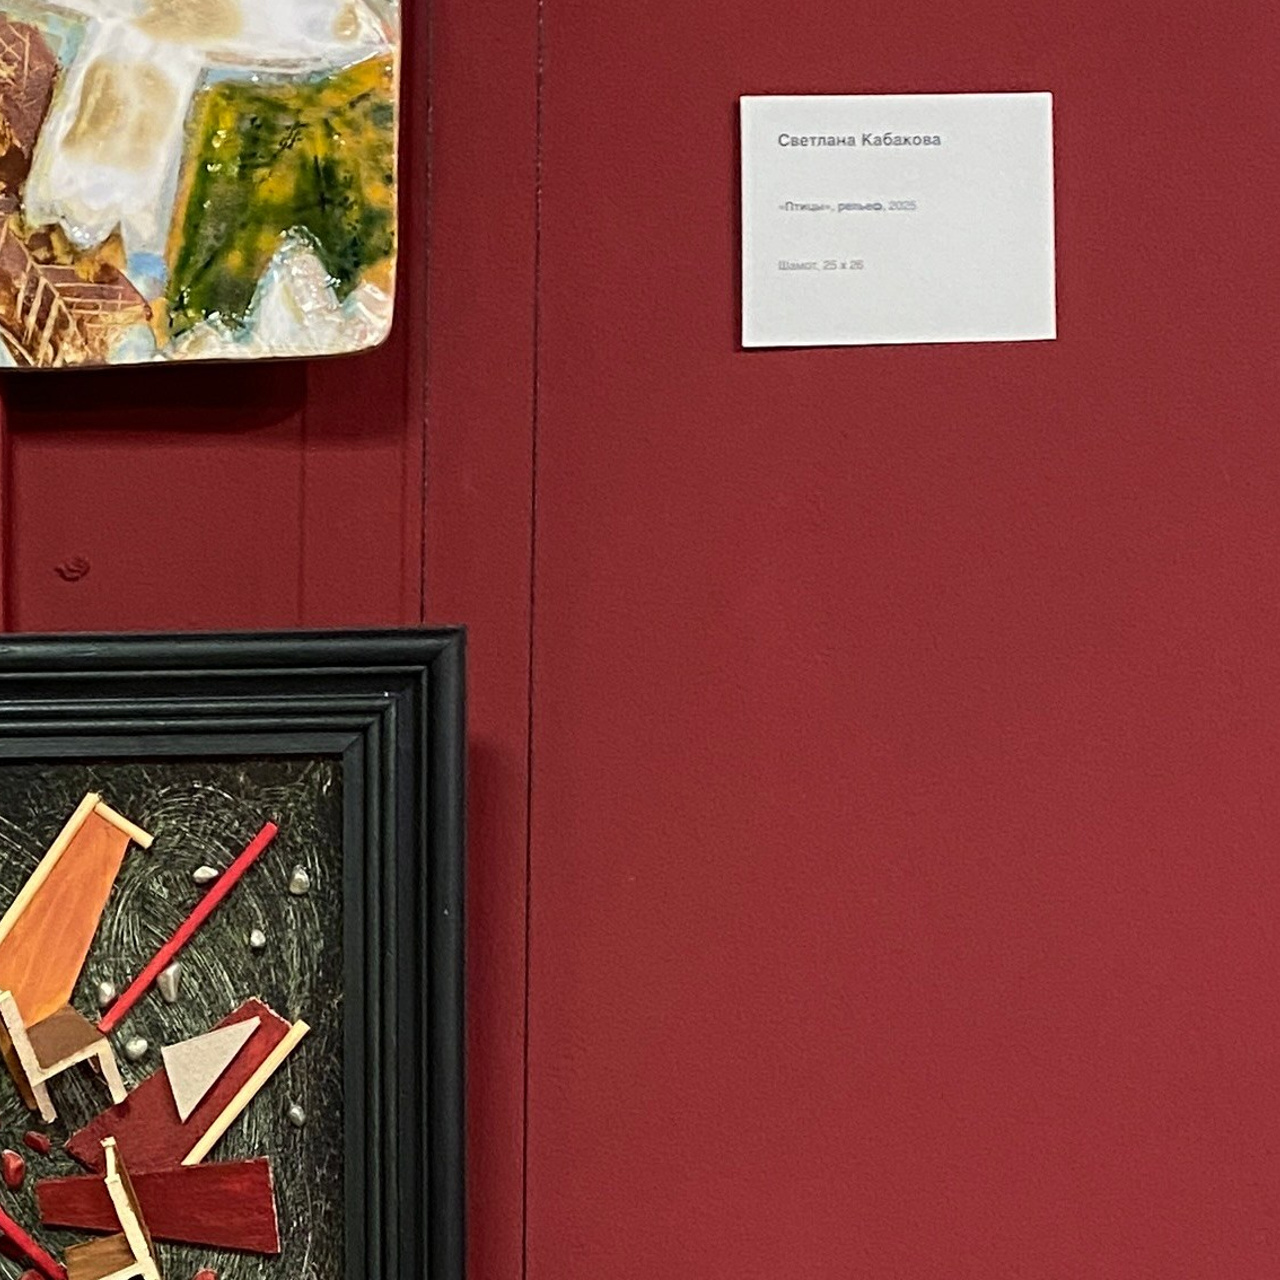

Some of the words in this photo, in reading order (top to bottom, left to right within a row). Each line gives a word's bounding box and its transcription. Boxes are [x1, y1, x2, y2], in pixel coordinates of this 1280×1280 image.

[778, 133, 856, 147] Светлана
[861, 132, 942, 146] Кабакова
[888, 200, 917, 211] 2025
[823, 260, 837, 270] 25
